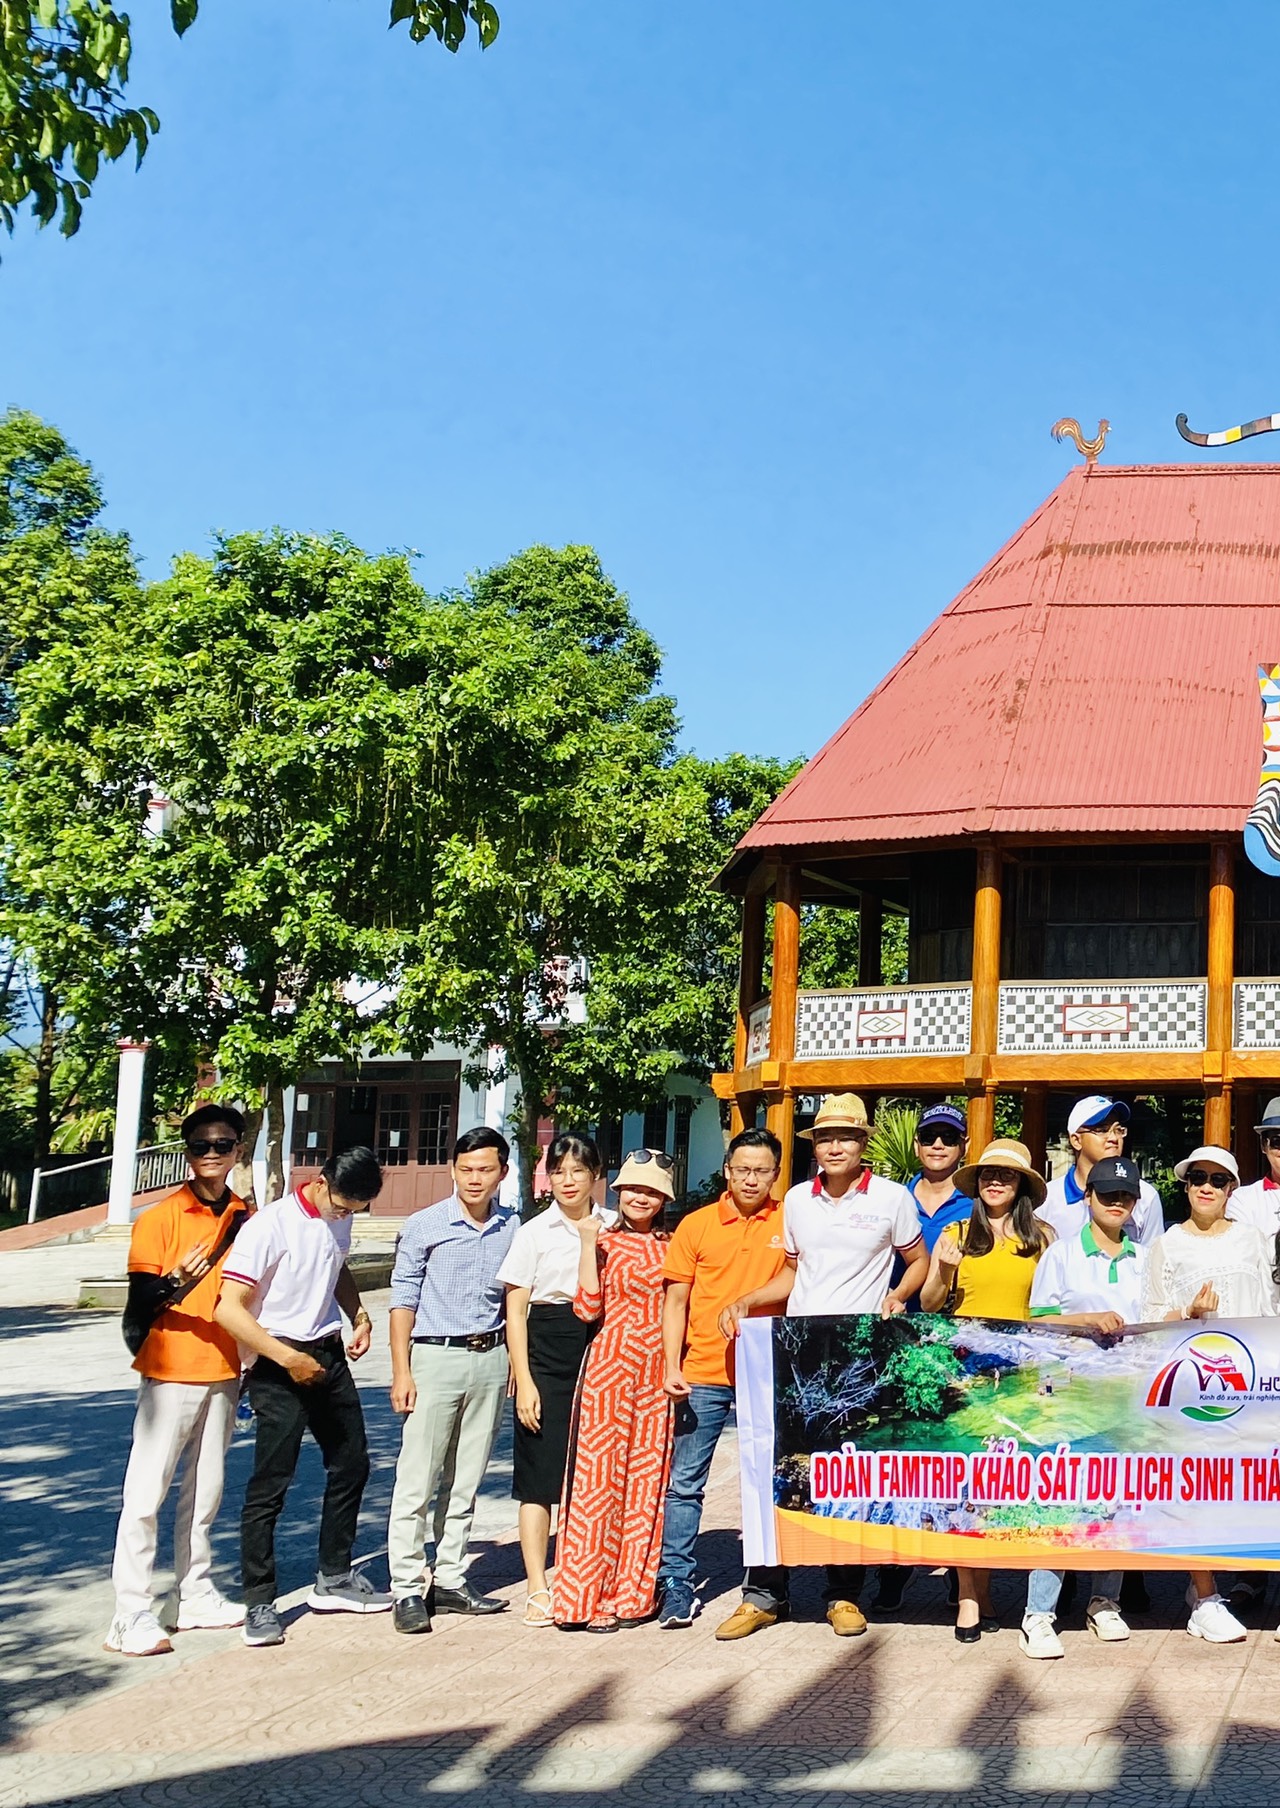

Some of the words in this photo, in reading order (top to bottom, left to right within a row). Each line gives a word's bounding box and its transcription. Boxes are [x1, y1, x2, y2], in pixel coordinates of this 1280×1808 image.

[1256, 1394, 1280, 1402] nghiệm
[814, 1446, 871, 1499] ĐOÀN
[879, 1455, 966, 1499] FAMTRIP
[972, 1441, 1031, 1501] KHẢO
[1038, 1447, 1081, 1501] SÁT
[1086, 1457, 1118, 1500] DU
[1123, 1456, 1174, 1511] LỊCH
[1180, 1457, 1234, 1501] SINH
